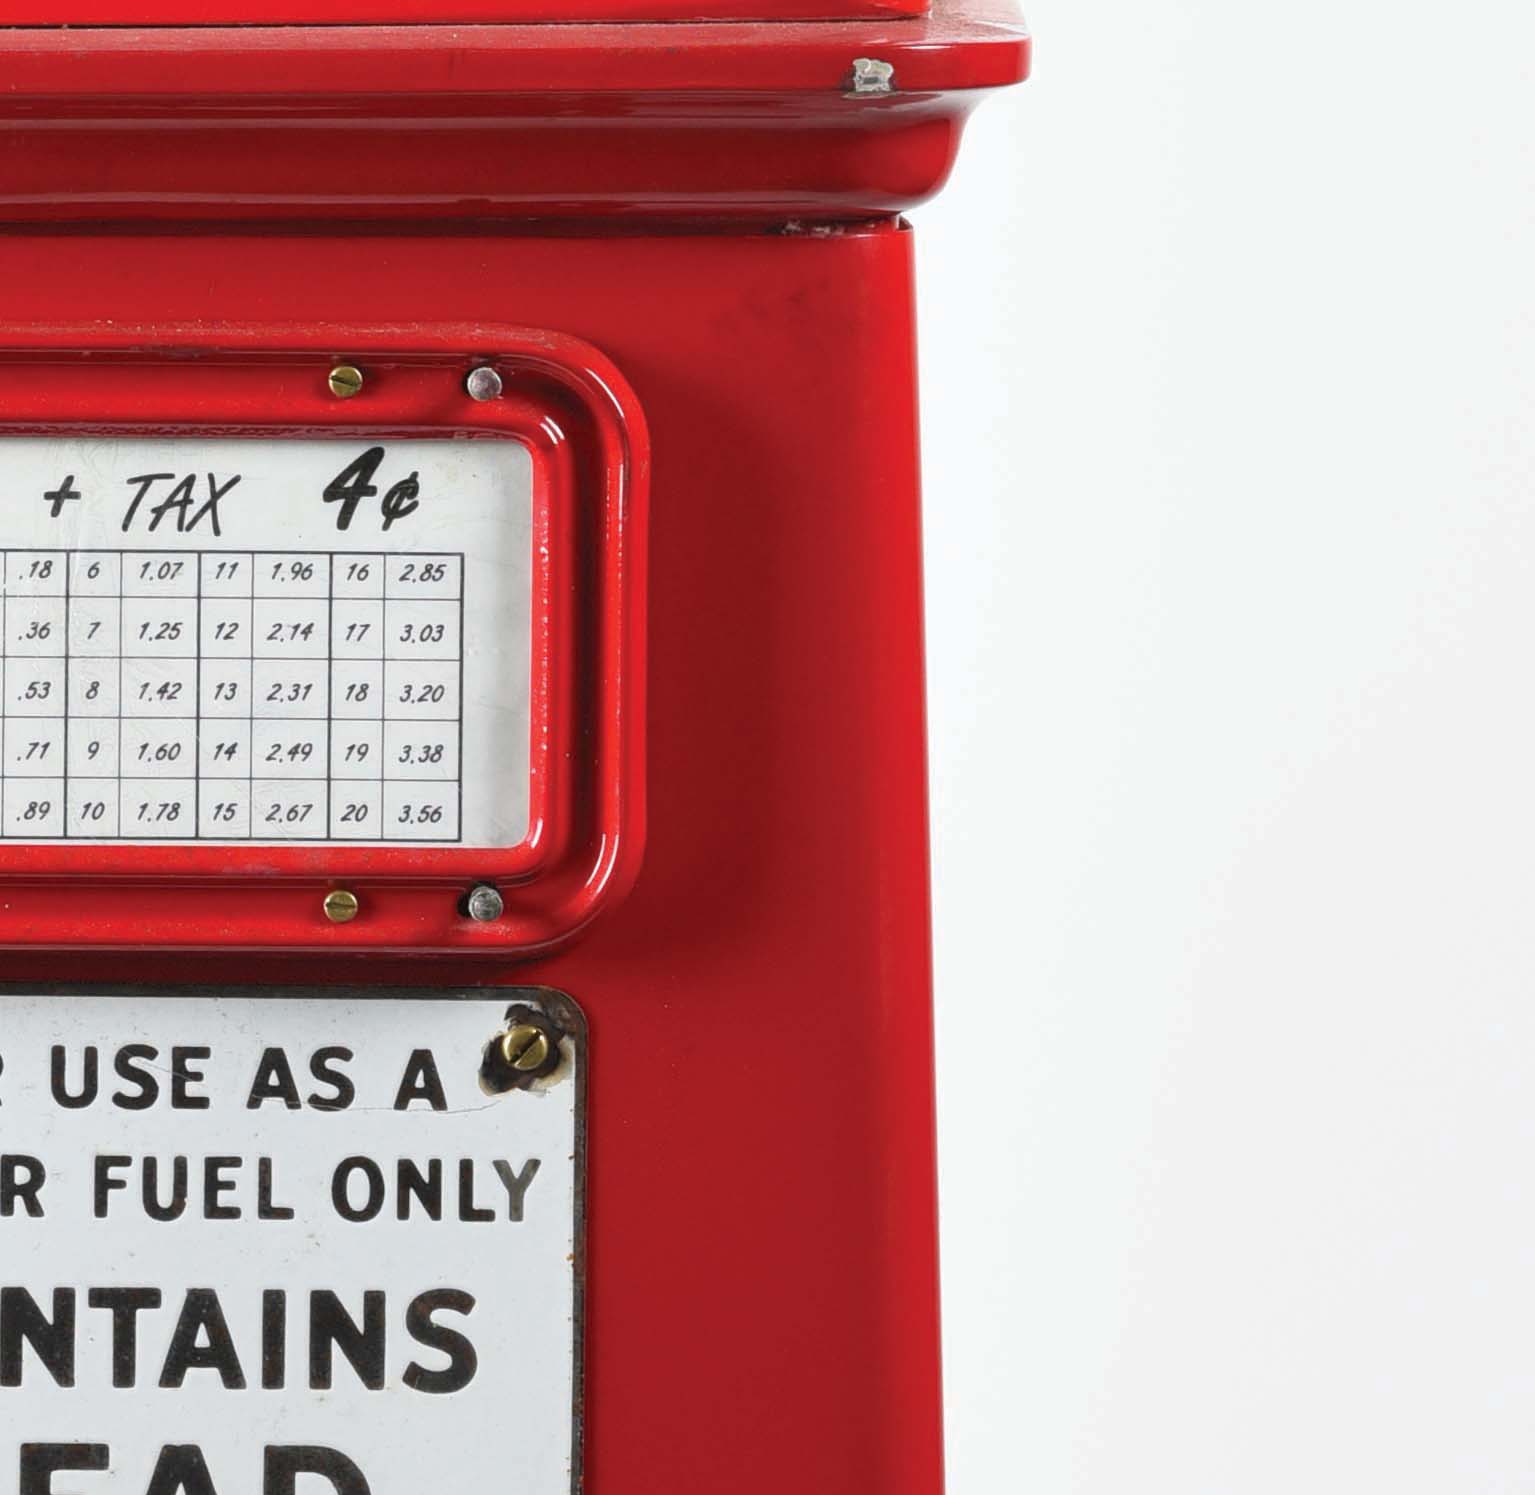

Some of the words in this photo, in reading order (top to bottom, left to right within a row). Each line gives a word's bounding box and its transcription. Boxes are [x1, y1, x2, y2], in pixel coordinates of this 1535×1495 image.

[122, 473, 241, 536] TAX
[19, 560, 53, 579] .18
[88, 562, 100, 579] 6
[140, 561, 184, 580] 1.07
[216, 562, 239, 579] 11
[272, 562, 313, 582] 1.96
[347, 563, 369, 581] 16
[399, 563, 447, 583] 2.85
[18, 622, 51, 640] .36
[88, 622, 101, 639] 7
[139, 622, 183, 641] 1.25
[215, 622, 239, 640] 12
[267, 623, 314, 642] 2.14
[346, 624, 370, 641] 17
[400, 624, 444, 643] 3.03
[18, 681, 51, 700] .53
[86, 681, 100, 699] 8
[139, 682, 182, 701] 1.42
[215, 683, 237, 700] 13
[266, 683, 312, 702] 2.31
[346, 683, 369, 702] 18
[400, 685, 445, 704] 3.20
[17, 742, 50, 761] .71
[88, 741, 99, 760] 9
[138, 743, 181, 762] 1.60
[214, 742, 238, 760] 14
[265, 743, 312, 763] 2.49
[345, 744, 369, 762] 19
[399, 744, 444, 764] 3.38
[17, 801, 50, 821] .89
[81, 802, 105, 820] 10
[138, 802, 181, 822] 1.78
[213, 803, 238, 821] 15
[265, 804, 313, 823] 2.67
[340, 804, 368, 822] 20
[398, 805, 442, 824] 3.56
[51, 1044, 210, 1110] USE
[247, 1046, 355, 1111] AS
[394, 1049, 447, 1111] A
[94, 1155, 294, 1221] FUEL
[331, 1156, 541, 1224] ONLY
